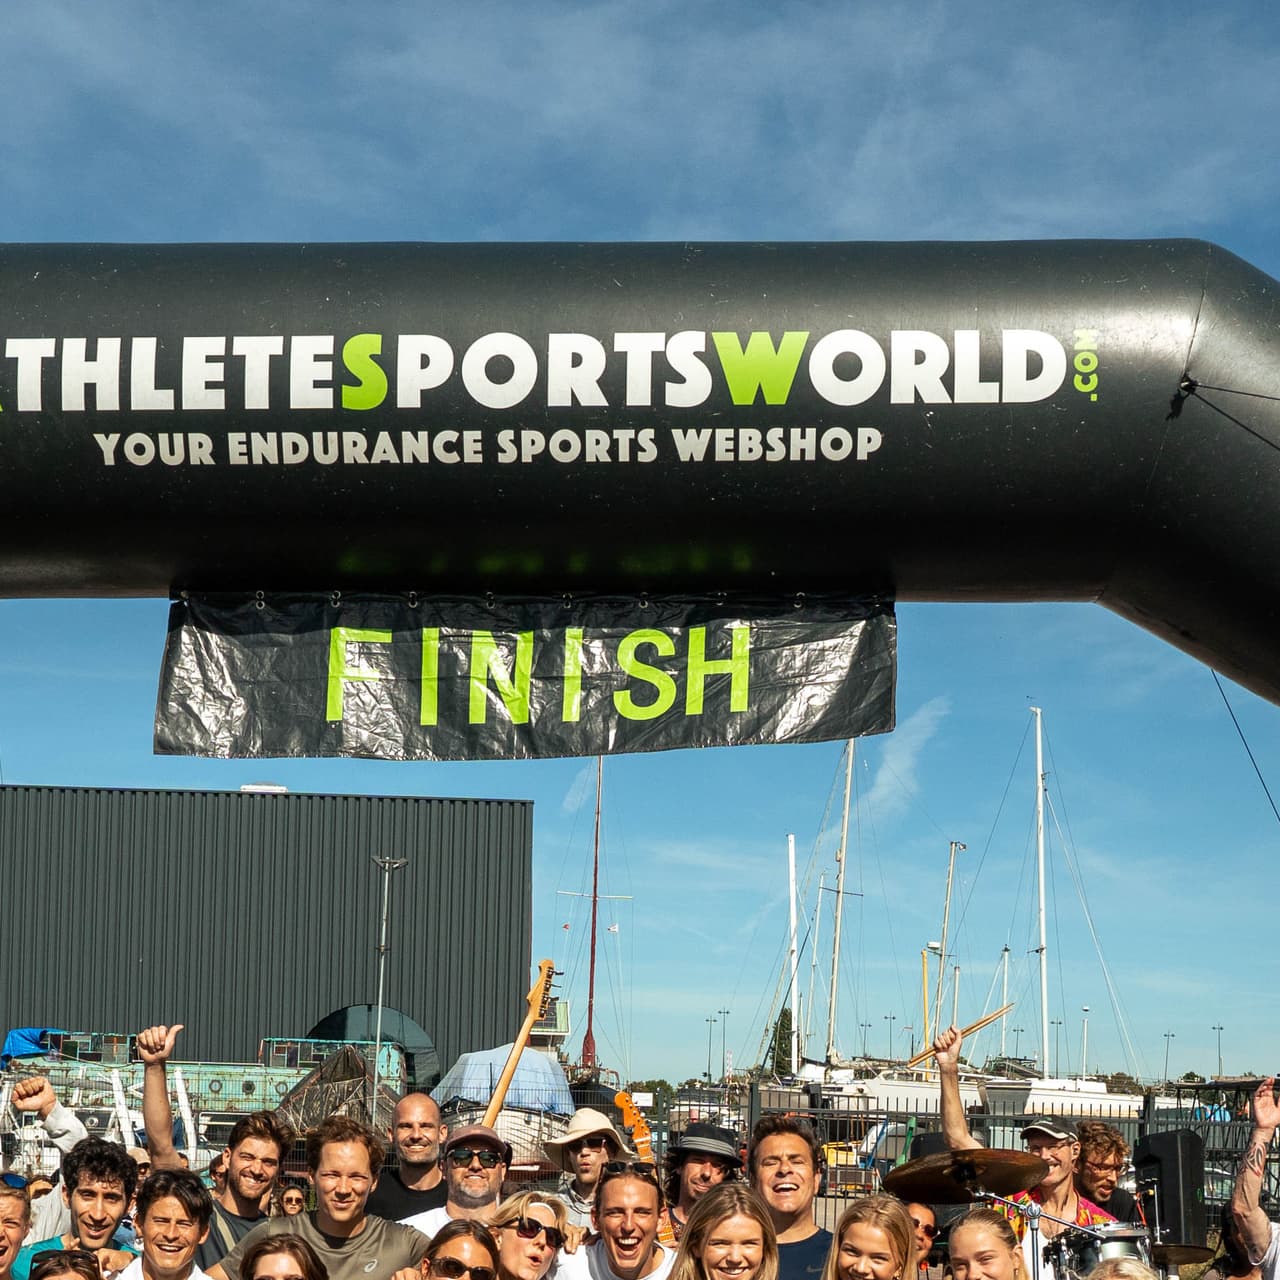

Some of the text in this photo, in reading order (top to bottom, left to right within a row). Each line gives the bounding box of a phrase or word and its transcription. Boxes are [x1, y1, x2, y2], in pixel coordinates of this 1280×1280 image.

[93, 426, 884, 468] YOUR ENDURANCE SPORTS WEBSHOP
[324, 622, 752, 727] FINISH
